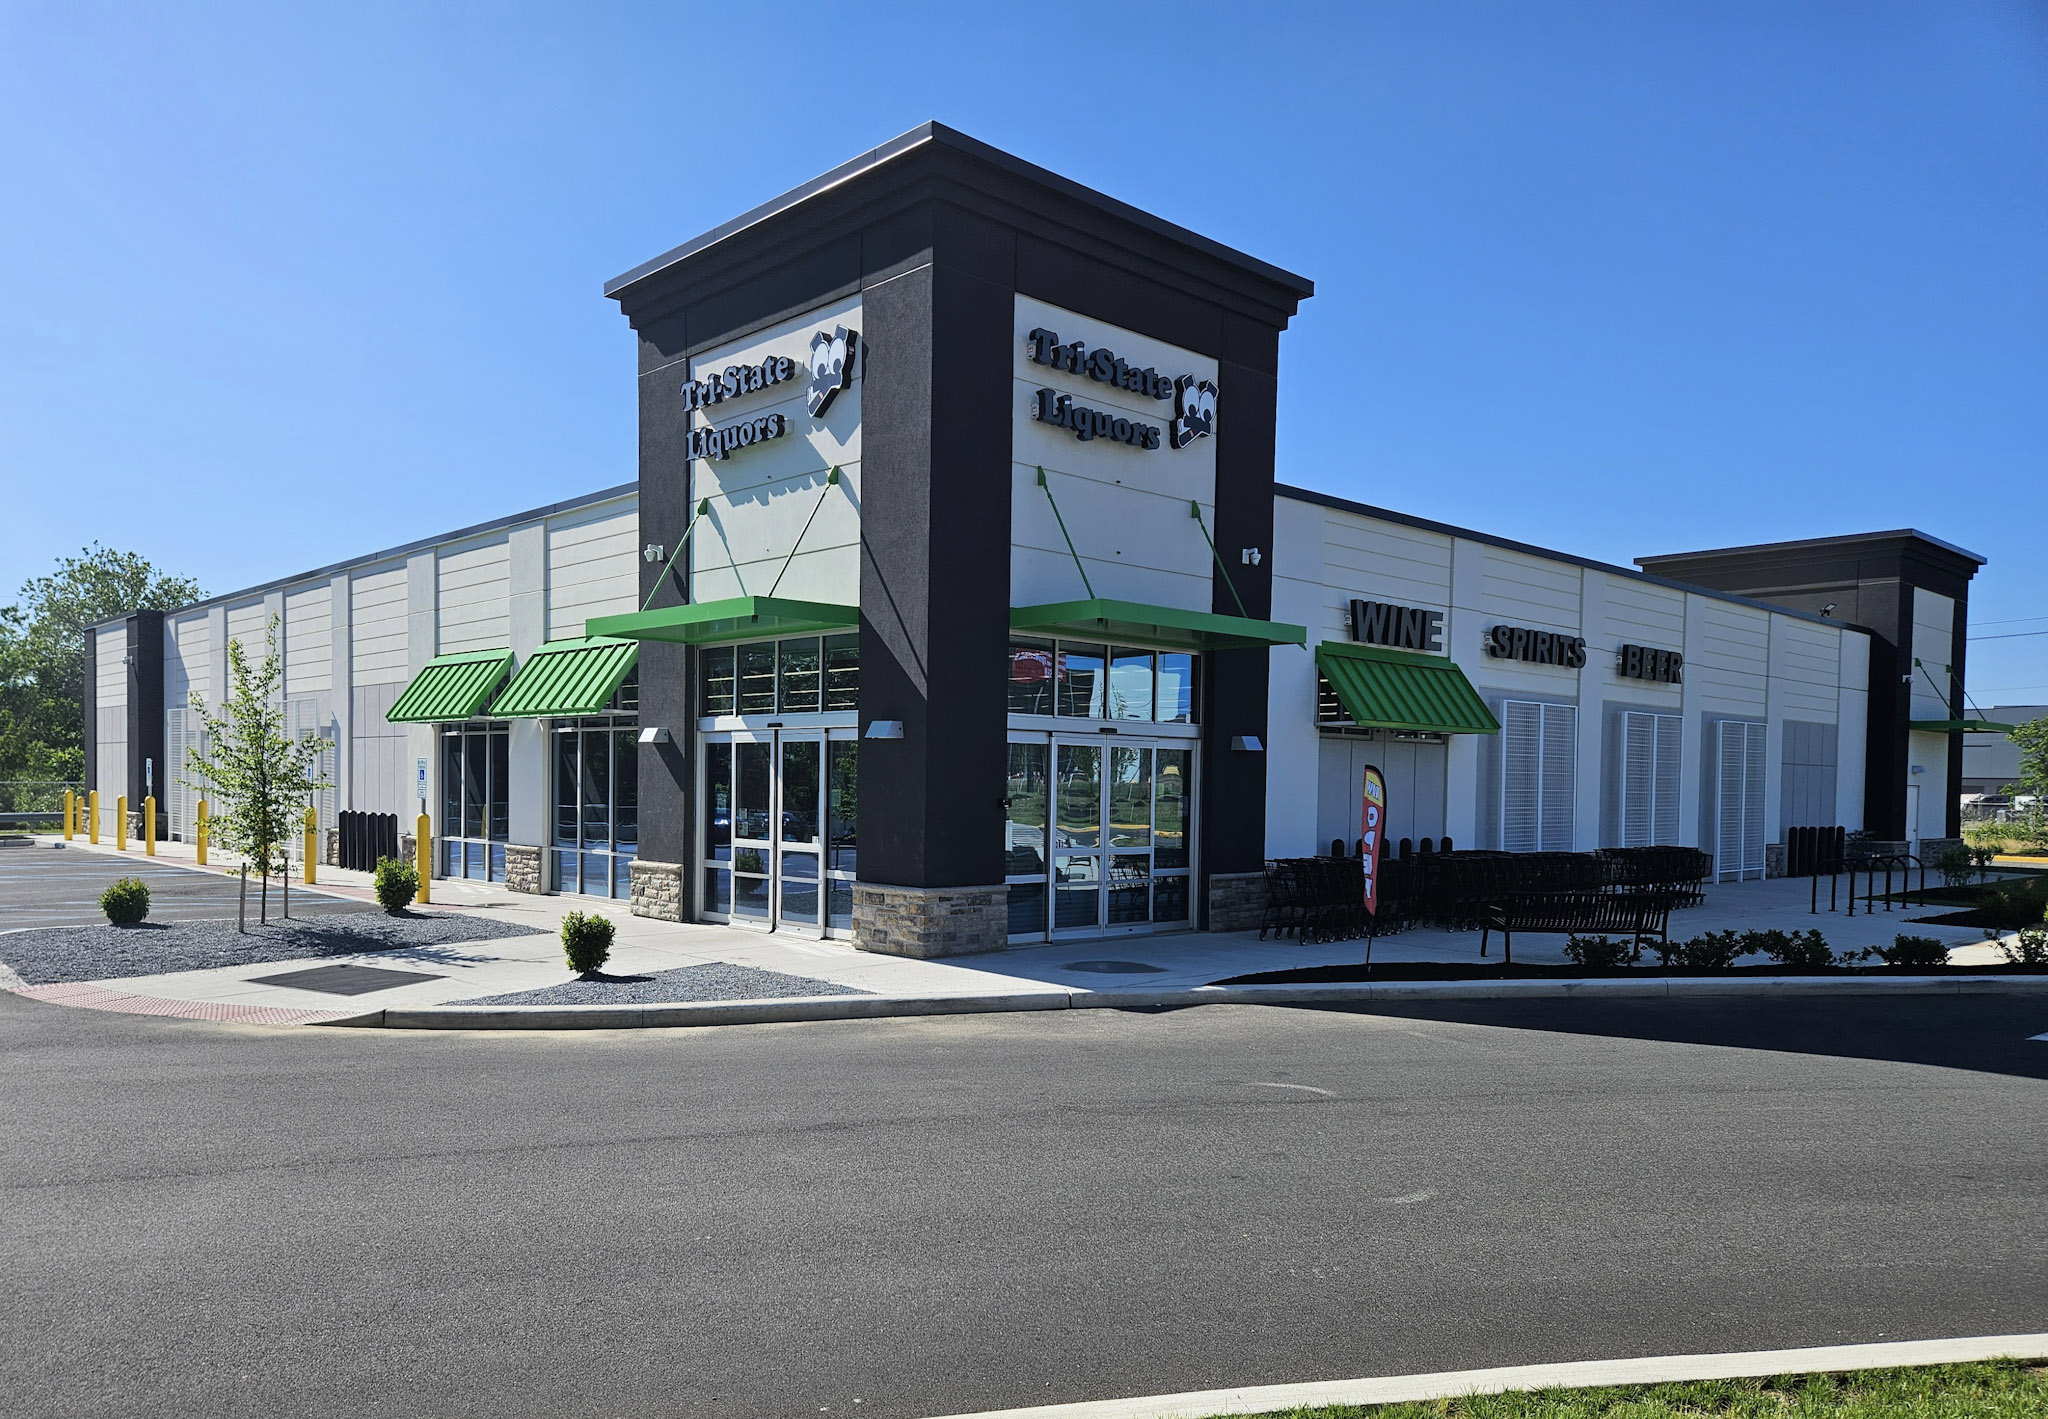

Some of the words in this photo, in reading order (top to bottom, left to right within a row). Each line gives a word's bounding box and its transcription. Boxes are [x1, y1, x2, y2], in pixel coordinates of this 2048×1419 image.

[680, 356, 794, 412] Tri-State
[1029, 328, 1173, 400] Tri-State
[686, 413, 785, 461] Liquors
[1036, 388, 1161, 450] Liquors
[1350, 599, 1443, 652] WINE
[1490, 625, 1587, 669] SPIRITS
[1620, 643, 1683, 684] BEER
